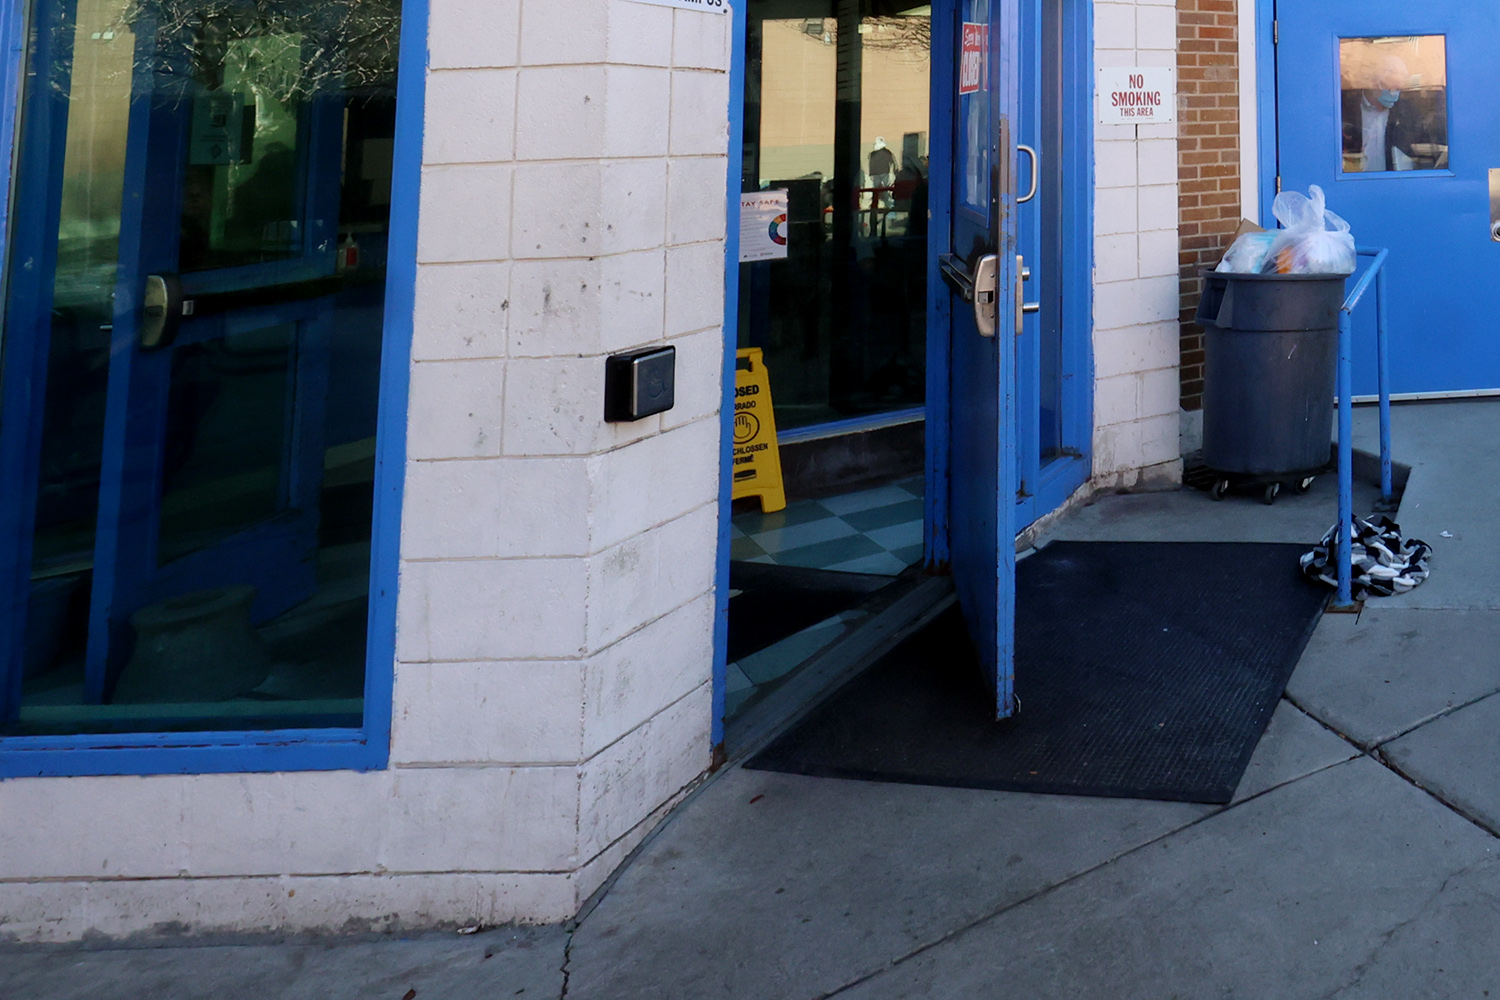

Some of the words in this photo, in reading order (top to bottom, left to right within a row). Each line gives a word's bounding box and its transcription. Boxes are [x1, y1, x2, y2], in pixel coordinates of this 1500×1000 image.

[1128, 74, 1144, 89] NO
[1111, 90, 1161, 107] SMOKING
[1120, 107, 1135, 117] THIS
[1136, 107, 1154, 117] AREA
